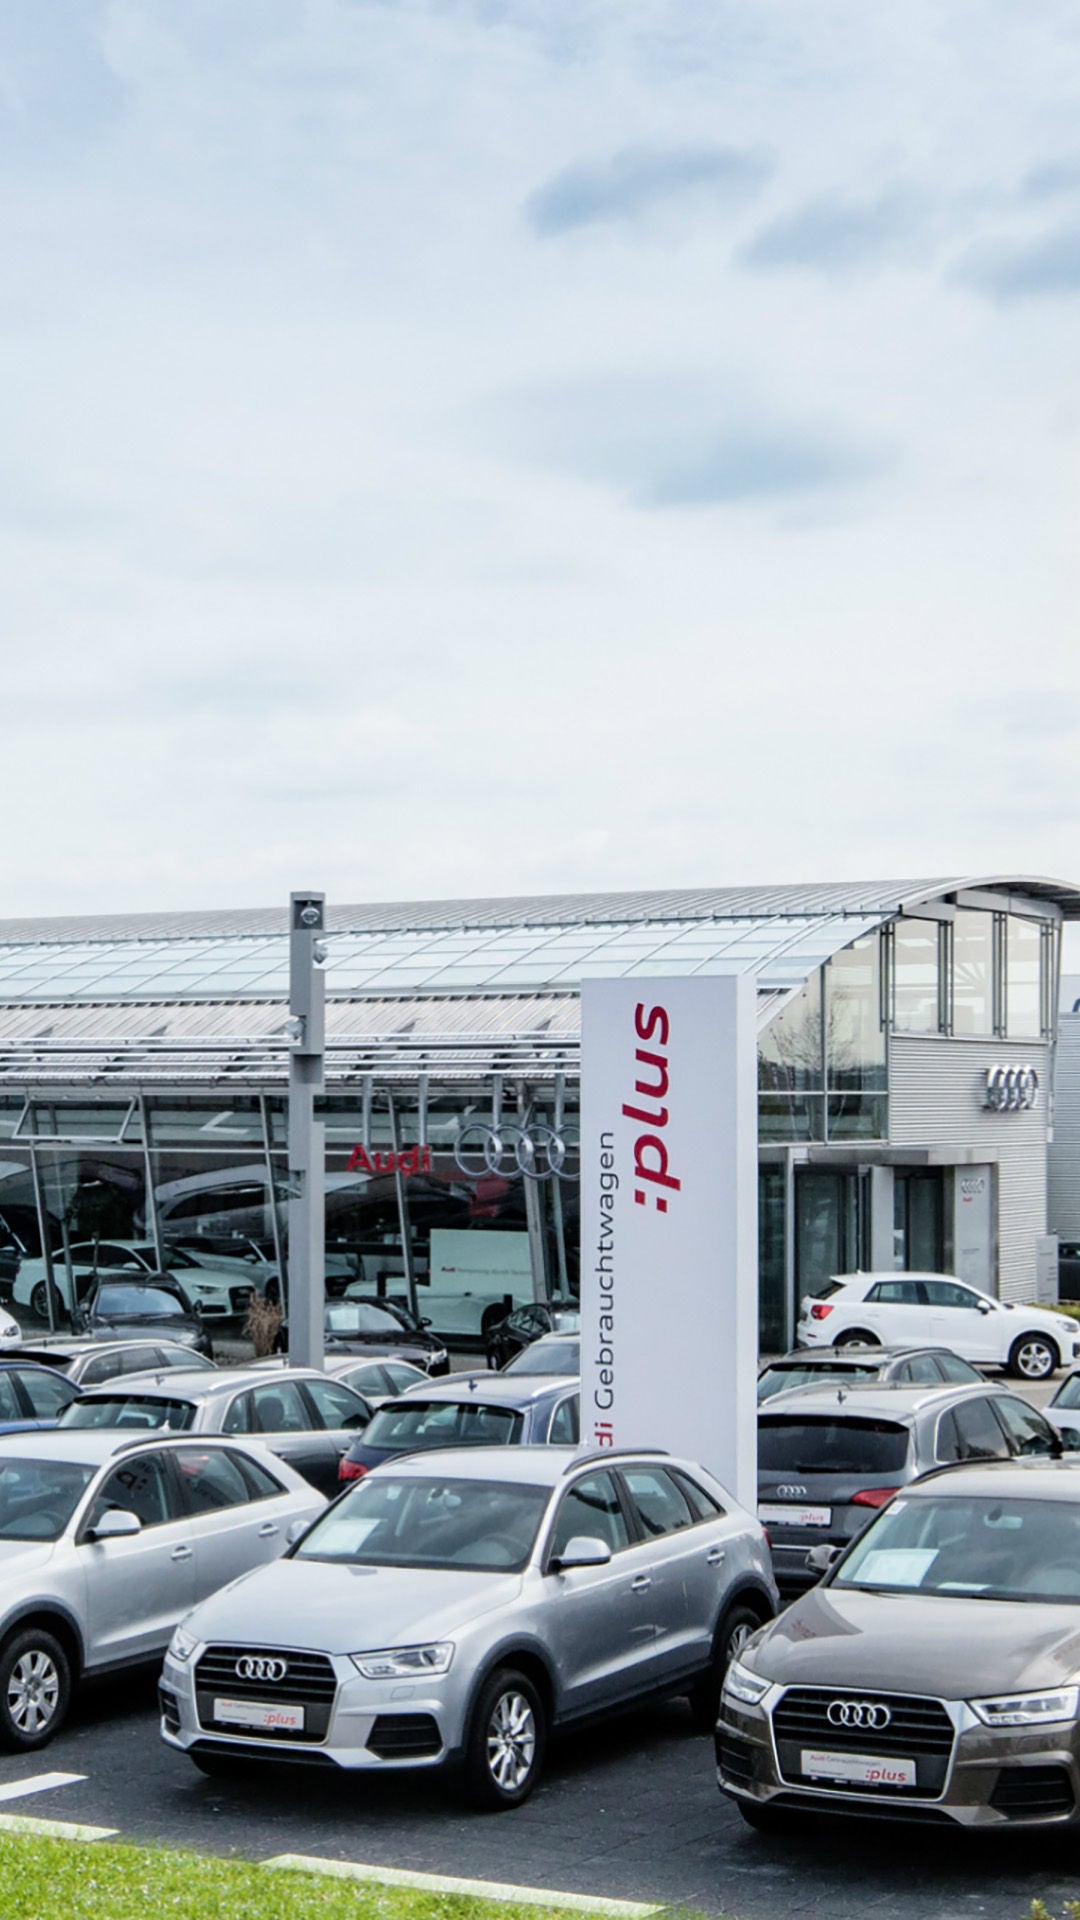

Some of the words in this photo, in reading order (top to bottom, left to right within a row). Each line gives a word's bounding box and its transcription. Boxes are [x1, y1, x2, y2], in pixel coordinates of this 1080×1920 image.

[621, 1003, 681, 1213] :plus
[345, 1144, 430, 1173] Audi
[594, 1131, 619, 1410] Gebrauchtwagen
[594, 1422, 613, 1447] di
[865, 1768, 907, 1782] :plus
